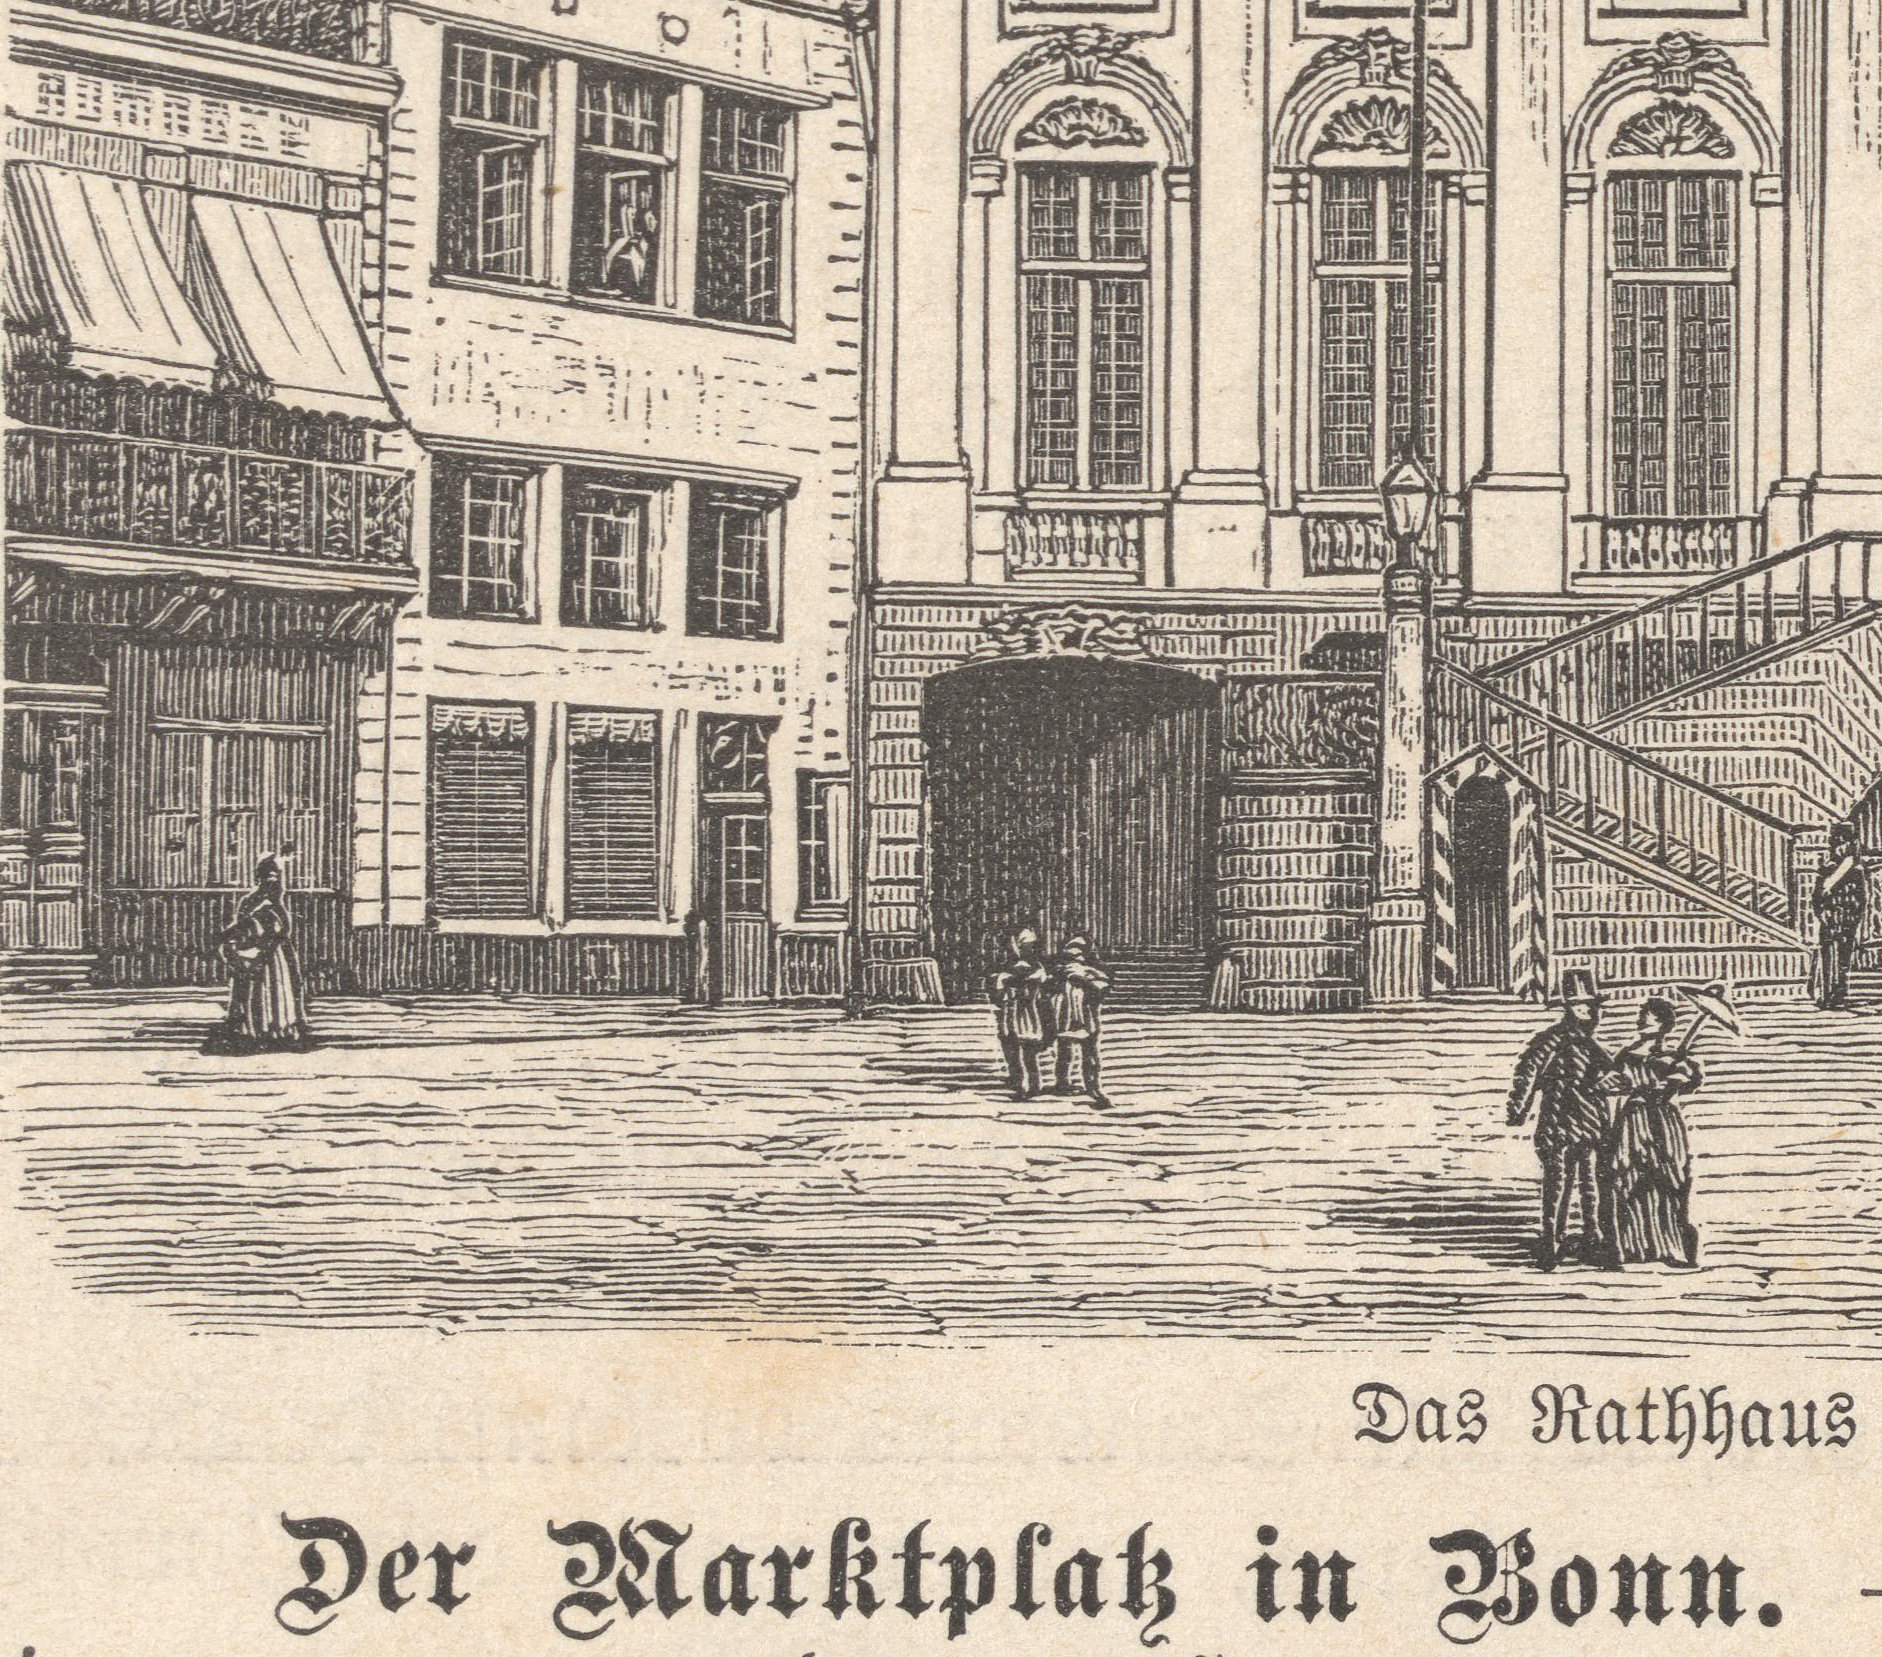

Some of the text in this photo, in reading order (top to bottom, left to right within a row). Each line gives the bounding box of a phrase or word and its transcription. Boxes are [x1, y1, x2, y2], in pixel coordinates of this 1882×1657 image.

[1352, 1381, 1488, 1445] Das
[1531, 1383, 1857, 1461] Rathhaus
[274, 1511, 477, 1637] Der
[546, 1516, 1177, 1649] Marktplatz
[1245, 1524, 1358, 1625] in
[1428, 1527, 1783, 1645] Bonn.
